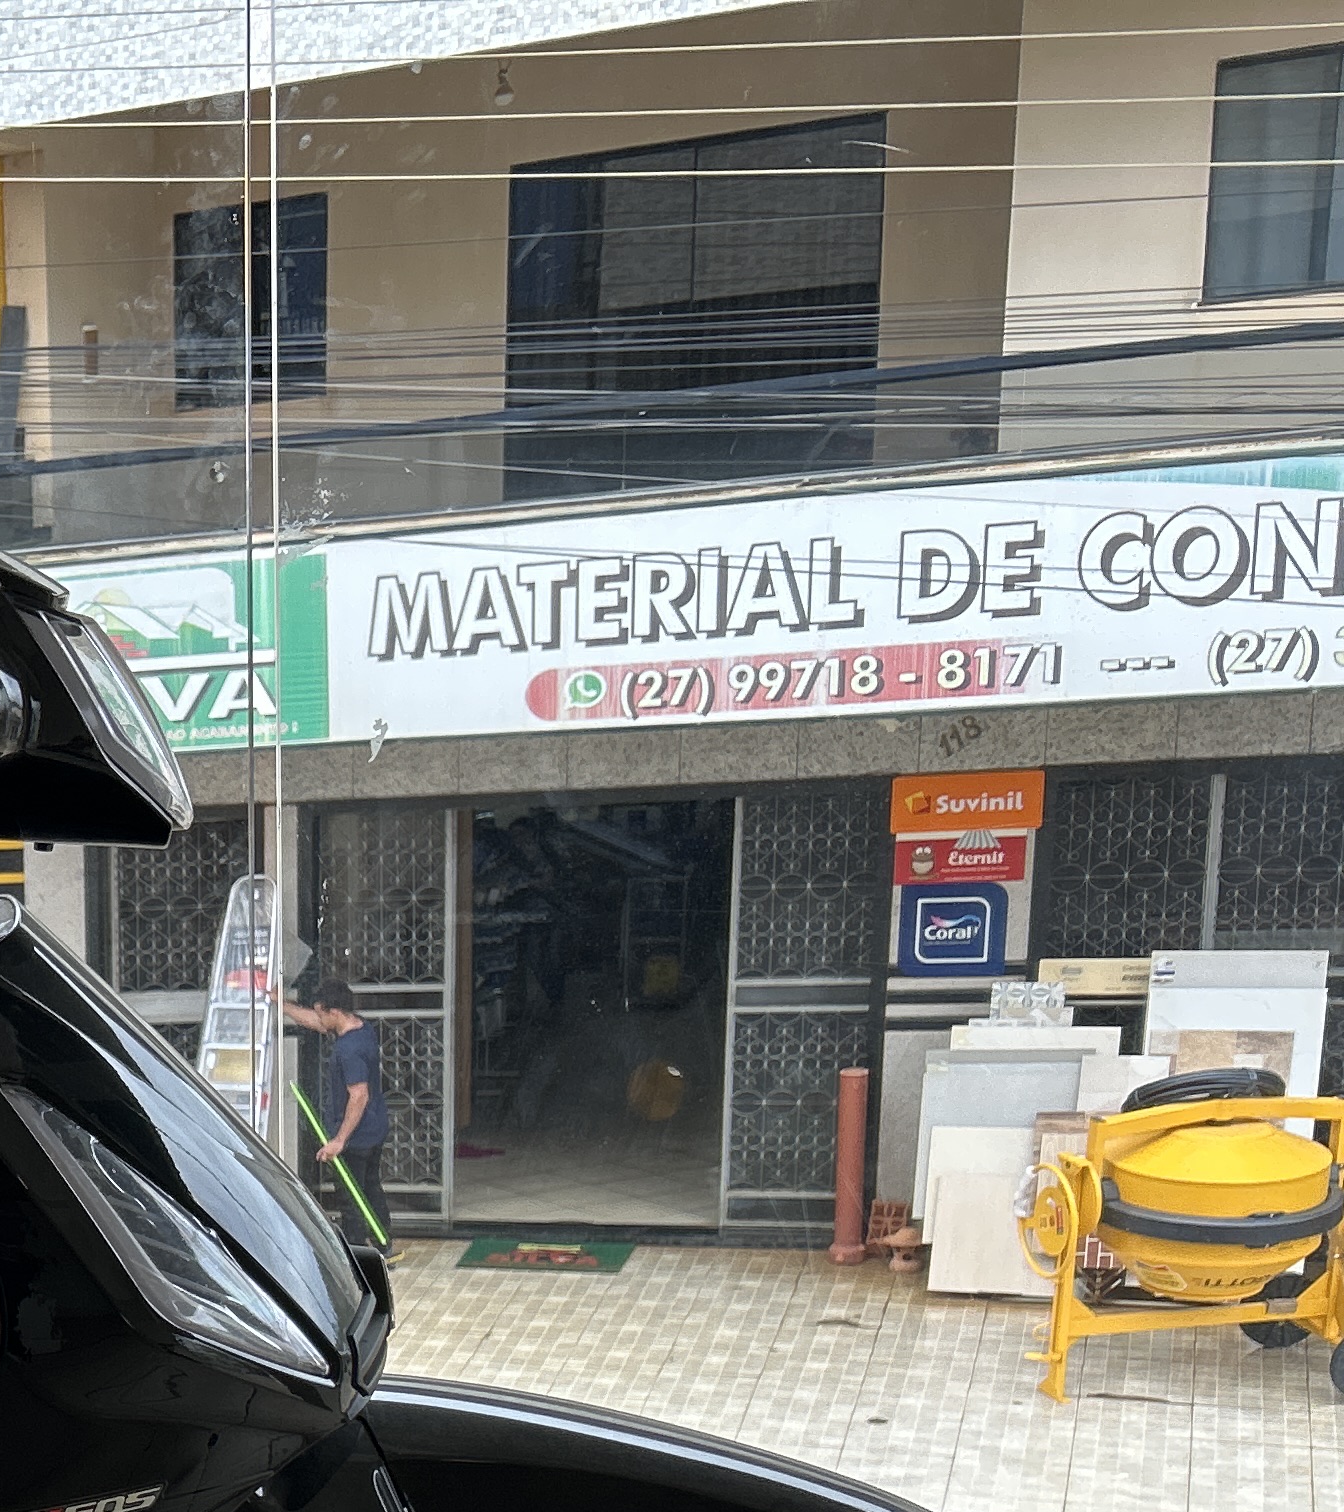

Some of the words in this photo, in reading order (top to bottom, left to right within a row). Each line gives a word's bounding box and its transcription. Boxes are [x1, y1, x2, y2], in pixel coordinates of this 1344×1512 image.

[367, 537, 865, 664] MATERIAL
[897, 520, 1045, 624] DE
[1078, 497, 1344, 612] CON
[620, 667, 714, 720] (27)
[727, 654, 885, 705] 99718
[935, 642, 1063, 691] 8171
[1207, 625, 1320, 687] (27)
[939, 714, 983, 757] 118
[935, 791, 1023, 814] Suvinil
[948, 850, 1005, 866] Eternit
[924, 924, 973, 941] Coral
